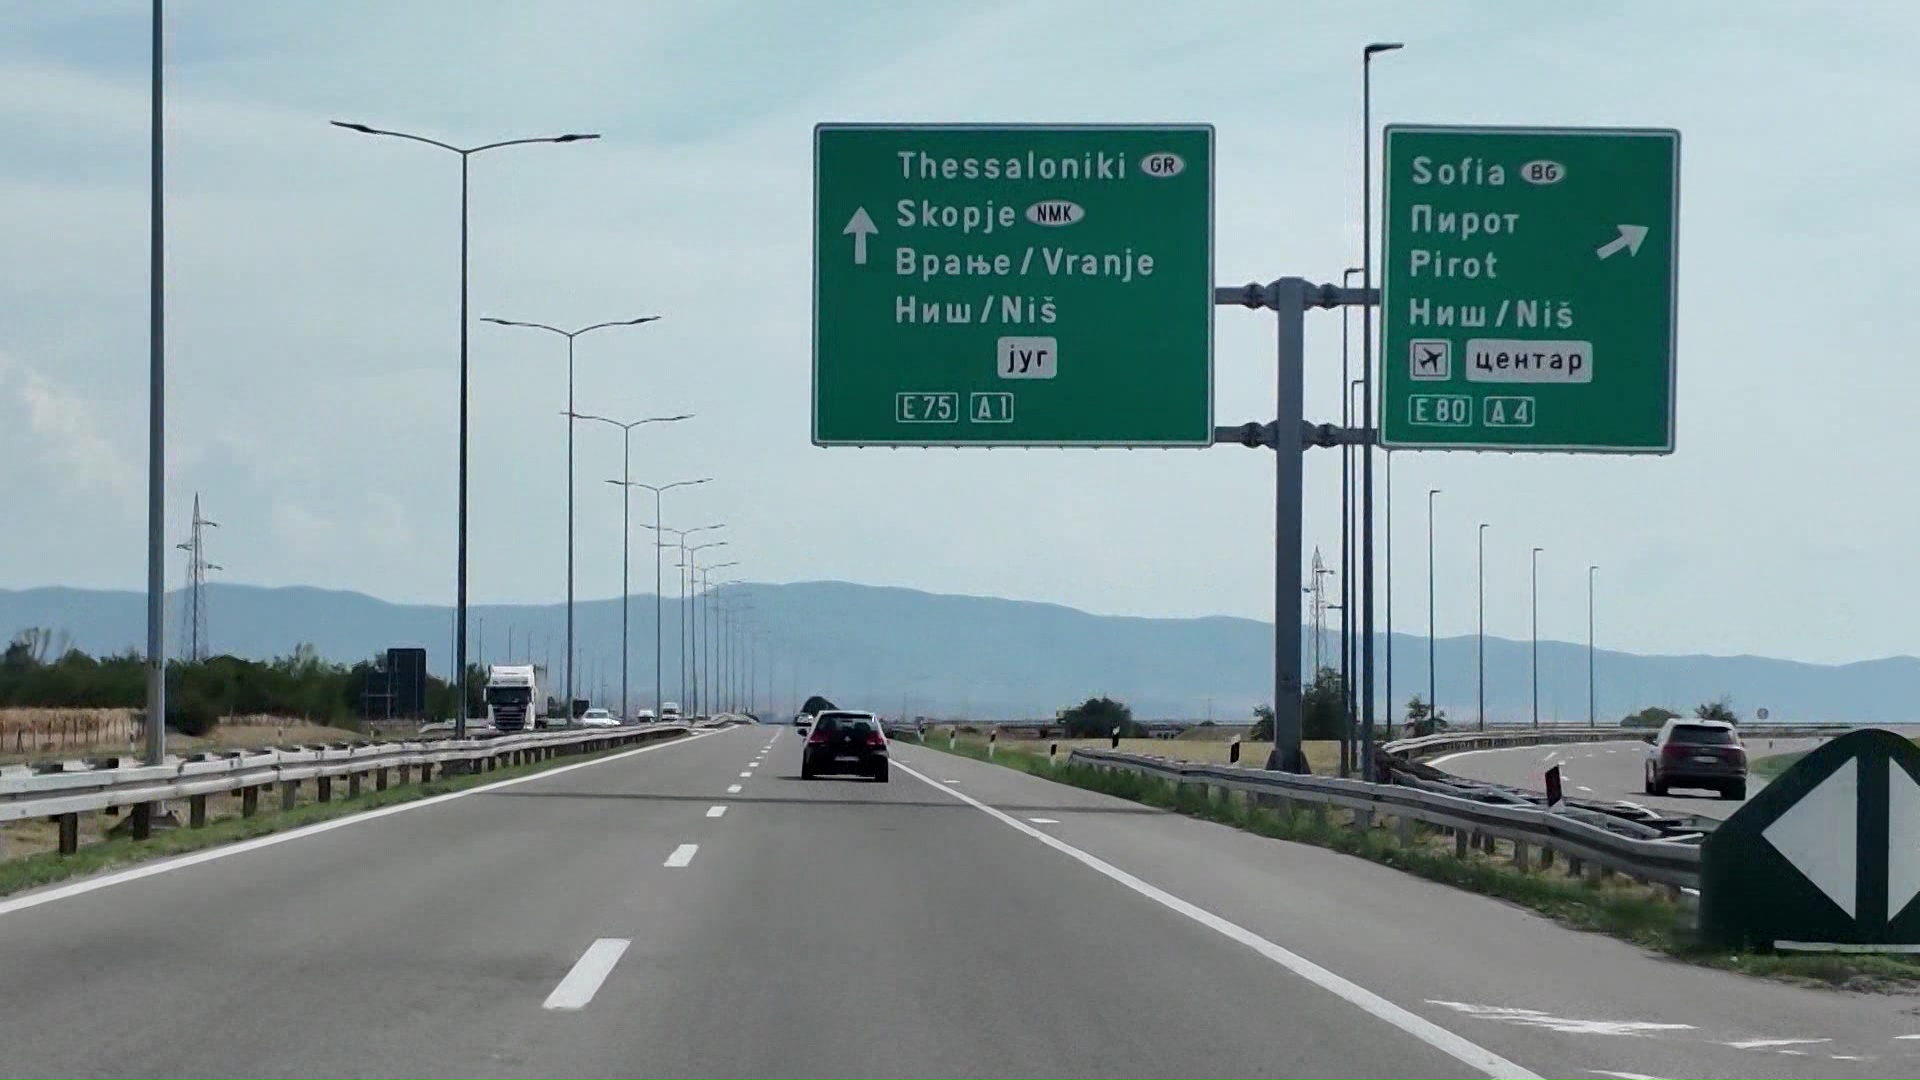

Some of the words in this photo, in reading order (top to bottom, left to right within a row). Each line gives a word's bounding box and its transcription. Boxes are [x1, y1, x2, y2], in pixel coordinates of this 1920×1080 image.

[897, 150, 1127, 180] Thessaloniki
[1149, 157, 1175, 173] GR
[1412, 156, 1506, 185] Sofia
[1531, 164, 1557, 181] BG
[896, 199, 1016, 234] Skopje
[1036, 205, 1072, 222] NMK
[1411, 205, 1520, 240] Пирот
[1410, 250, 1498, 279] Pirot
[1006, 344, 1048, 373] југ
[1475, 351, 1582, 375] центар
